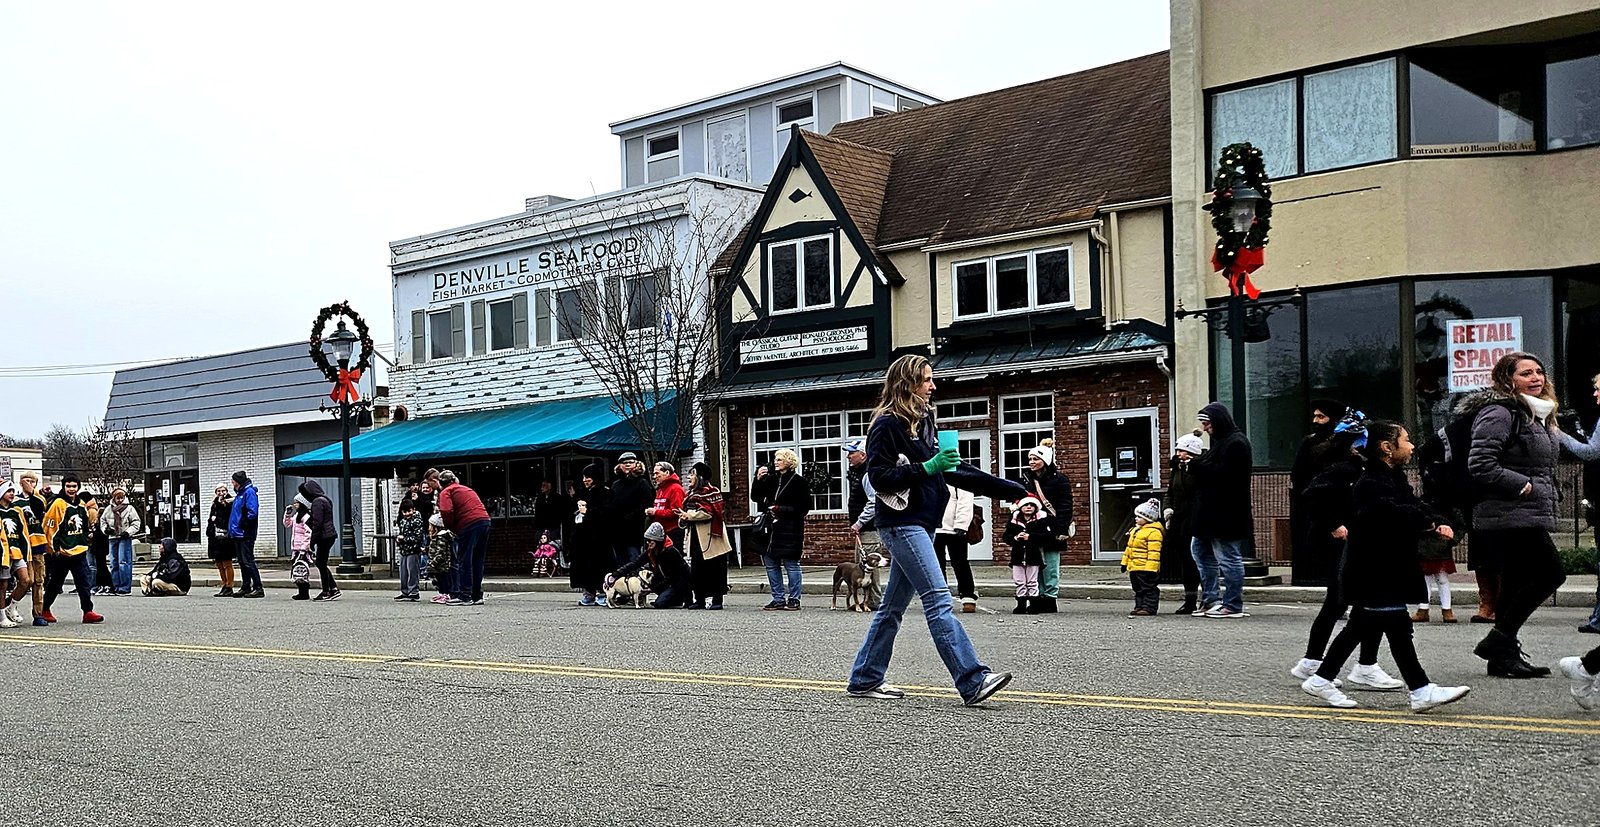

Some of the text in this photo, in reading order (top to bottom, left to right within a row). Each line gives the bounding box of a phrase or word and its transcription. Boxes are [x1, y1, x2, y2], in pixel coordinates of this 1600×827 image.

[1411, 146, 1448, 155] Entrance
[1449, 146, 1457, 154] at
[1460, 145, 1469, 153] 40
[1471, 142, 1517, 153] Bloomfield
[434, 236, 638, 290] DENVILLE SEAFOOD
[432, 289, 457, 301] FISH
[461, 279, 506, 296] MARKET
[517, 262, 603, 286] CODMOTHER'S
[780, 334, 799, 342] GUITAR
[802, 330, 826, 339] RONALD
[813, 332, 855, 344] PSYCHOLOGIST
[1453, 322, 1516, 344] RETAIL
[760, 342, 781, 350] STUDIO
[789, 347, 819, 358] ARCHITECT
[1453, 373, 1492, 387] 973-625
